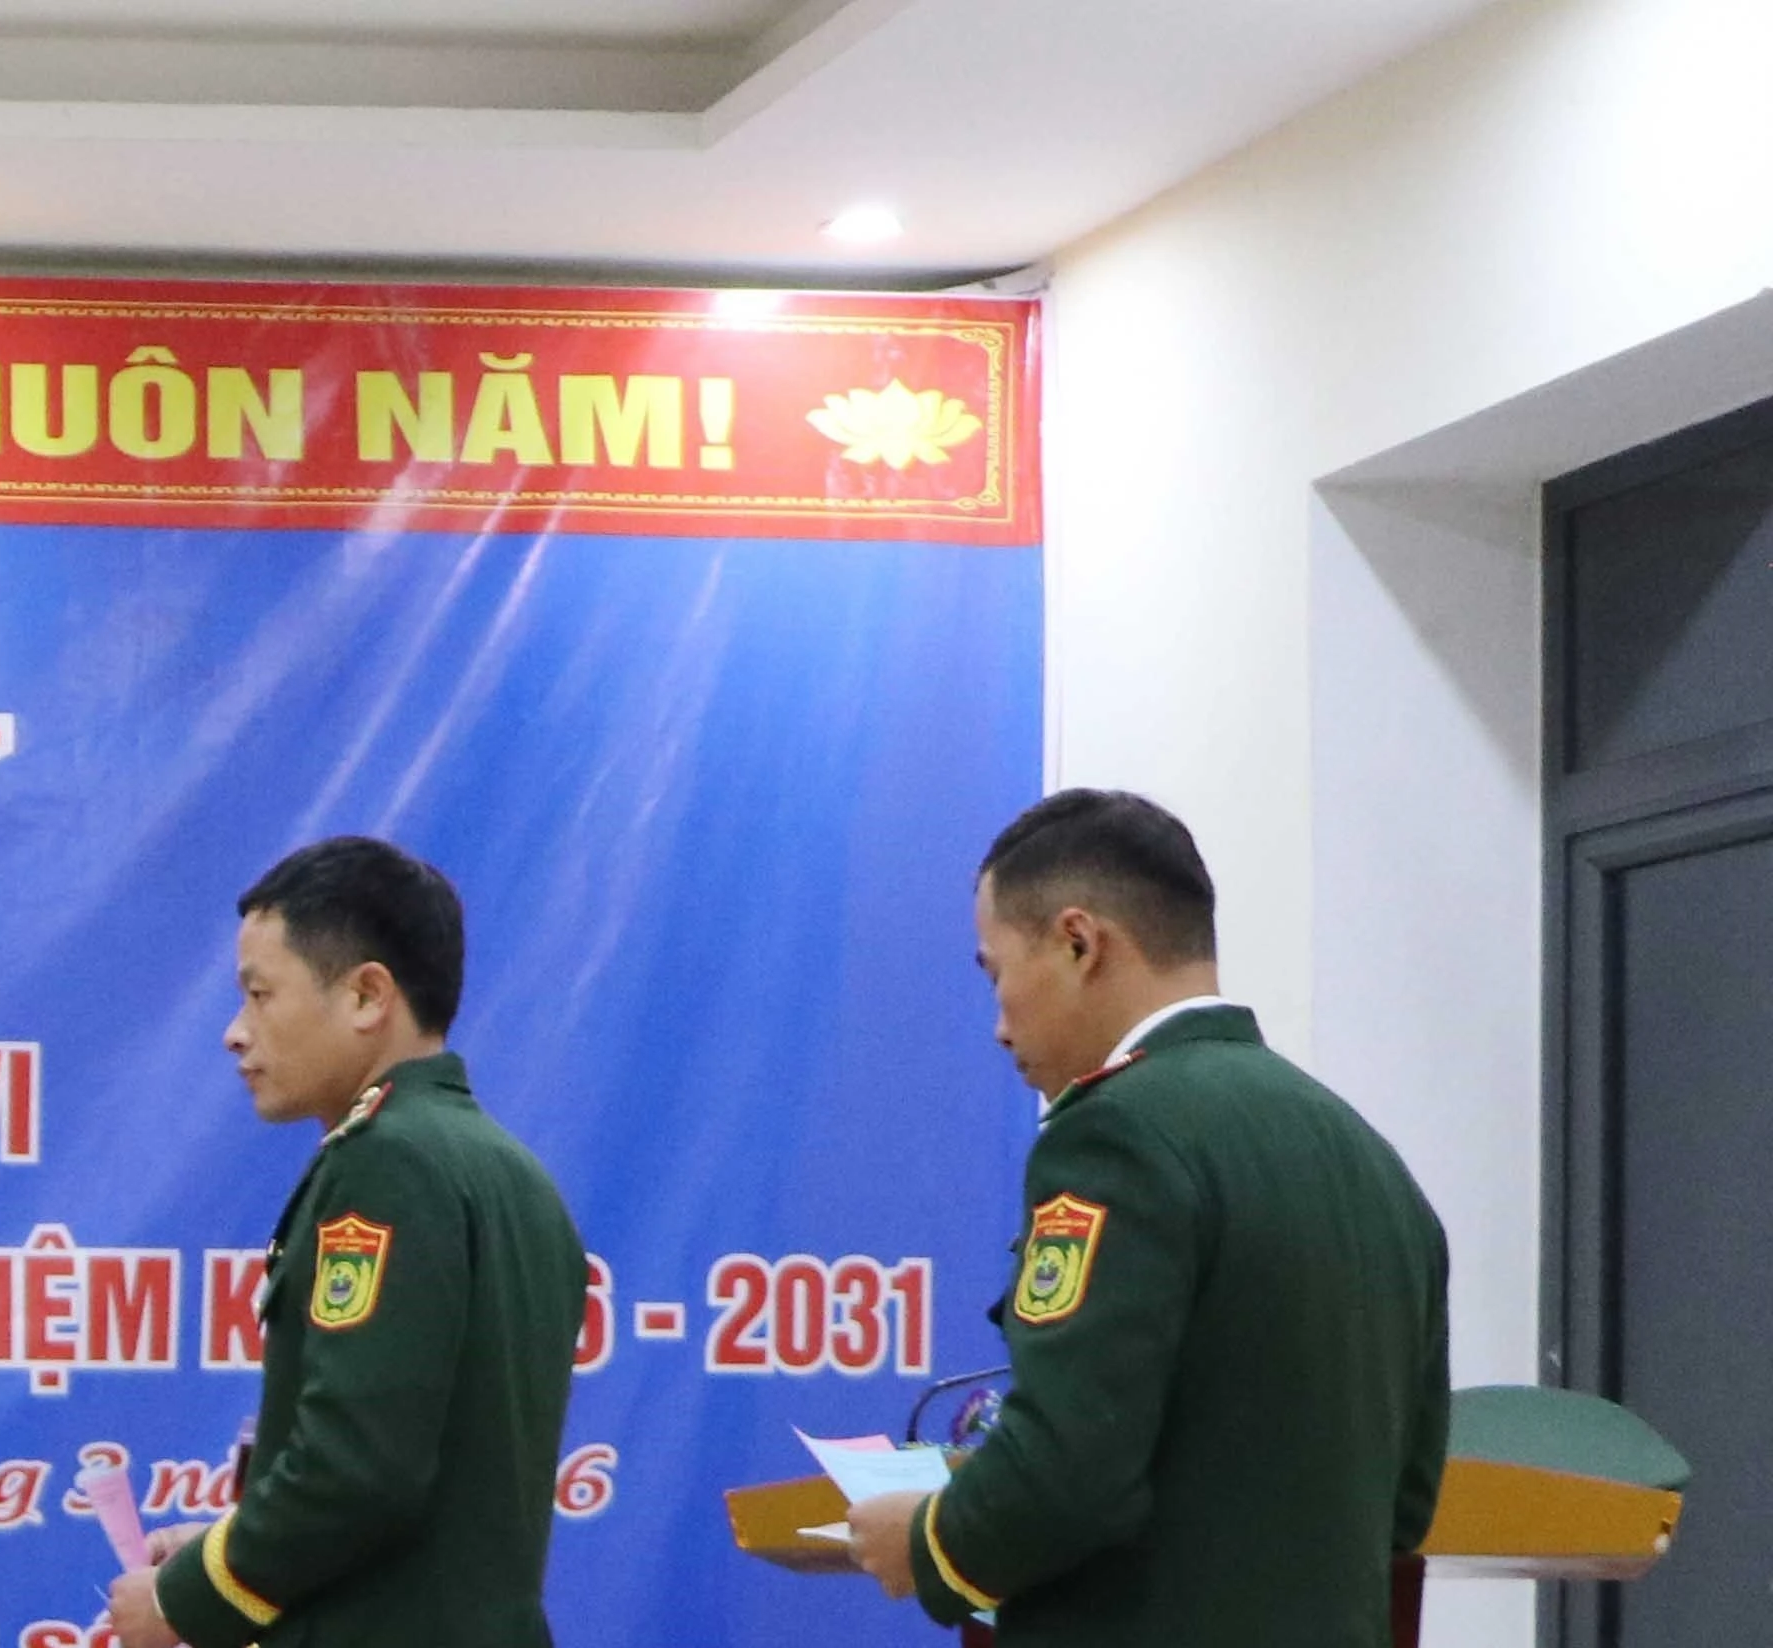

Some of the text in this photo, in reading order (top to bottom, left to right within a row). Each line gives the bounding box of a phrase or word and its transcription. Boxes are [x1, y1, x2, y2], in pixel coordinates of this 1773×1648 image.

[358, 354, 735, 468] NĂM!
[635, 1303, 684, 1338] -
[706, 1254, 931, 1375] 2031
